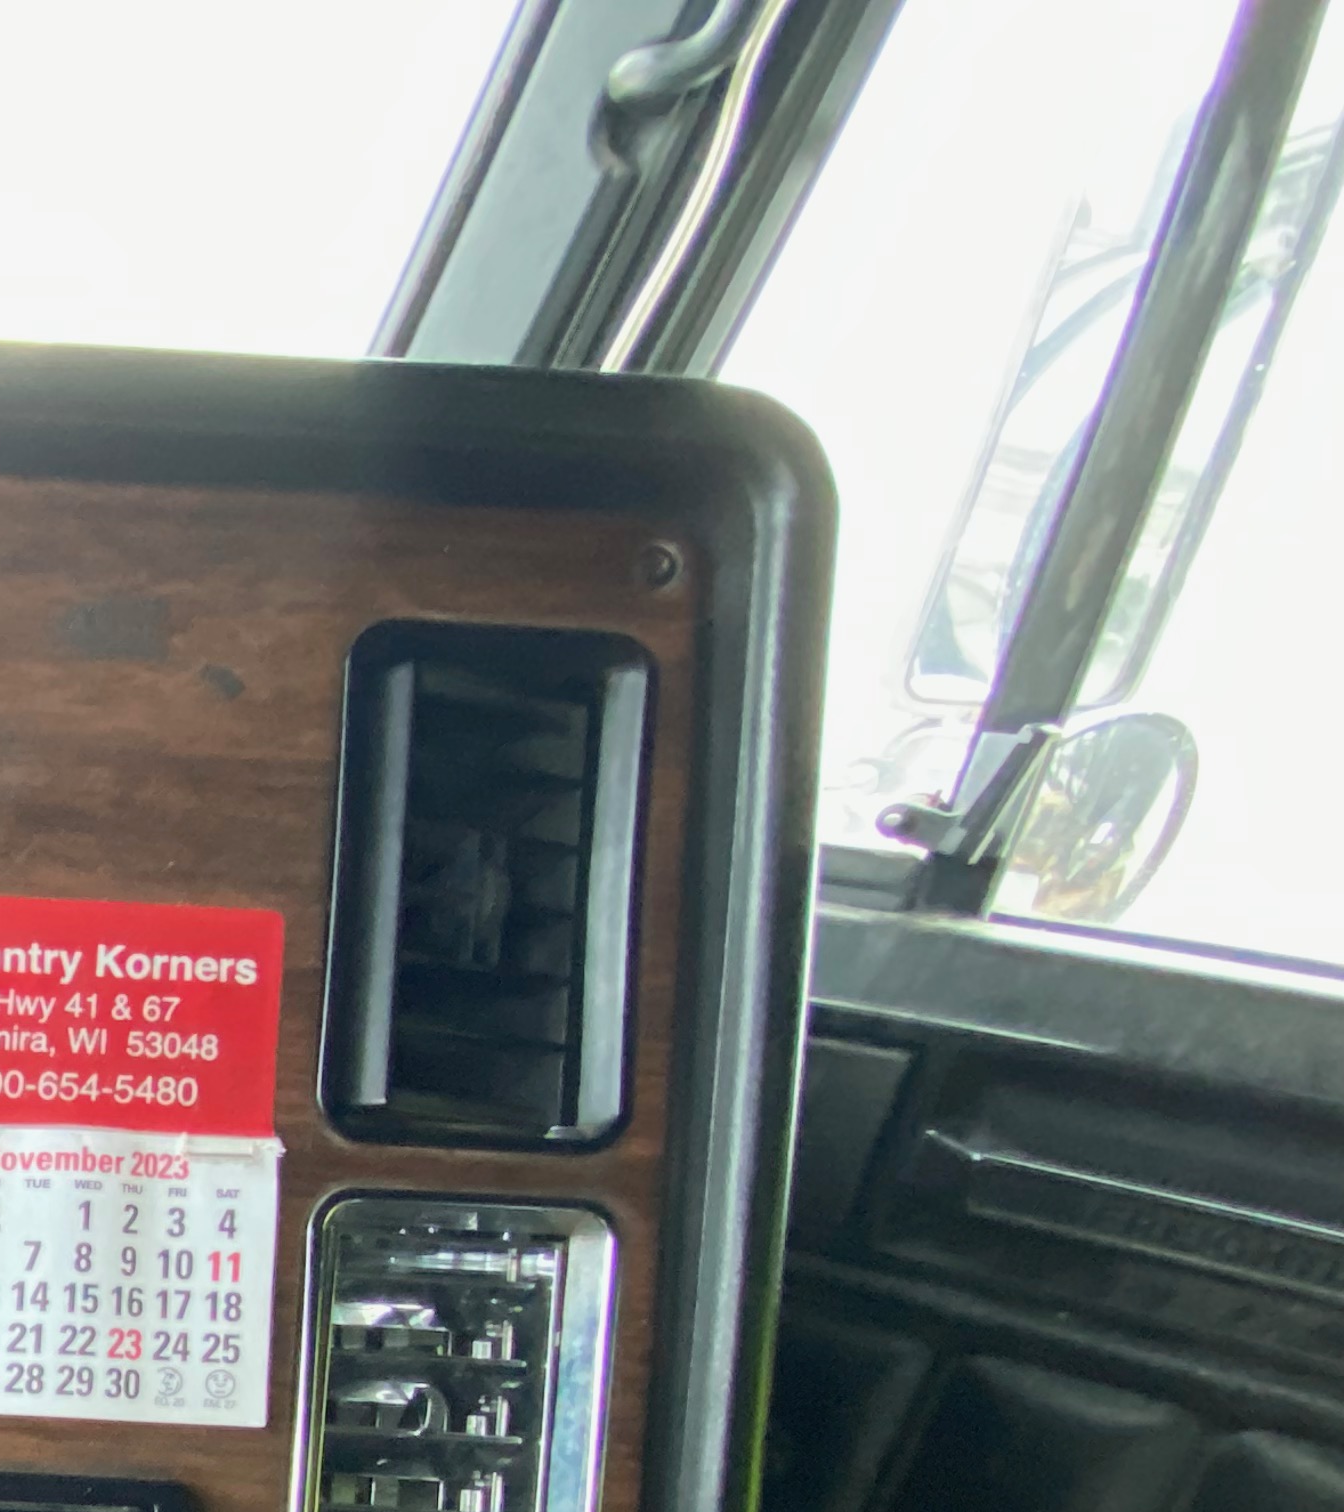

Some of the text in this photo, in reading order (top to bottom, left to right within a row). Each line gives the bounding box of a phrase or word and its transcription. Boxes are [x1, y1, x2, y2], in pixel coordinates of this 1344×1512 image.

[95, 944, 258, 985] Korners
[64, 992, 99, 1016] 41
[111, 994, 132, 1020] &
[142, 996, 181, 1022] 67
[68, 1026, 107, 1055] WI
[126, 1031, 219, 1061] 53048
[130, 1151, 190, 1180] 2023
[25, 1178, 51, 1190] TUE
[74, 1179, 103, 1192] WED
[121, 1183, 143, 1195] THU
[168, 1186, 187, 1198] FRI
[216, 1188, 240, 1199] SAT
[78, 1200, 236, 1239] 1 2 3 4
[23, 1240, 42, 1272] 7
[74, 1242, 92, 1273] 8
[120, 1245, 137, 1276] 9
[158, 1248, 193, 1280] 10
[208, 1251, 241, 1283] 11
[12, 1281, 49, 1312] 14
[63, 1283, 100, 1315] 15
[112, 1285, 144, 1318] 16
[156, 1288, 191, 1320] 17
[205, 1290, 242, 1322] 18
[6, 1323, 43, 1354] 21
[58, 1325, 97, 1357] 22
[107, 1328, 143, 1360] 23
[152, 1331, 190, 1362] 24
[201, 1333, 241, 1365] 25
[4, 1362, 45, 1395] 28
[55, 1365, 94, 1397] 29
[104, 1367, 140, 1400] 30
